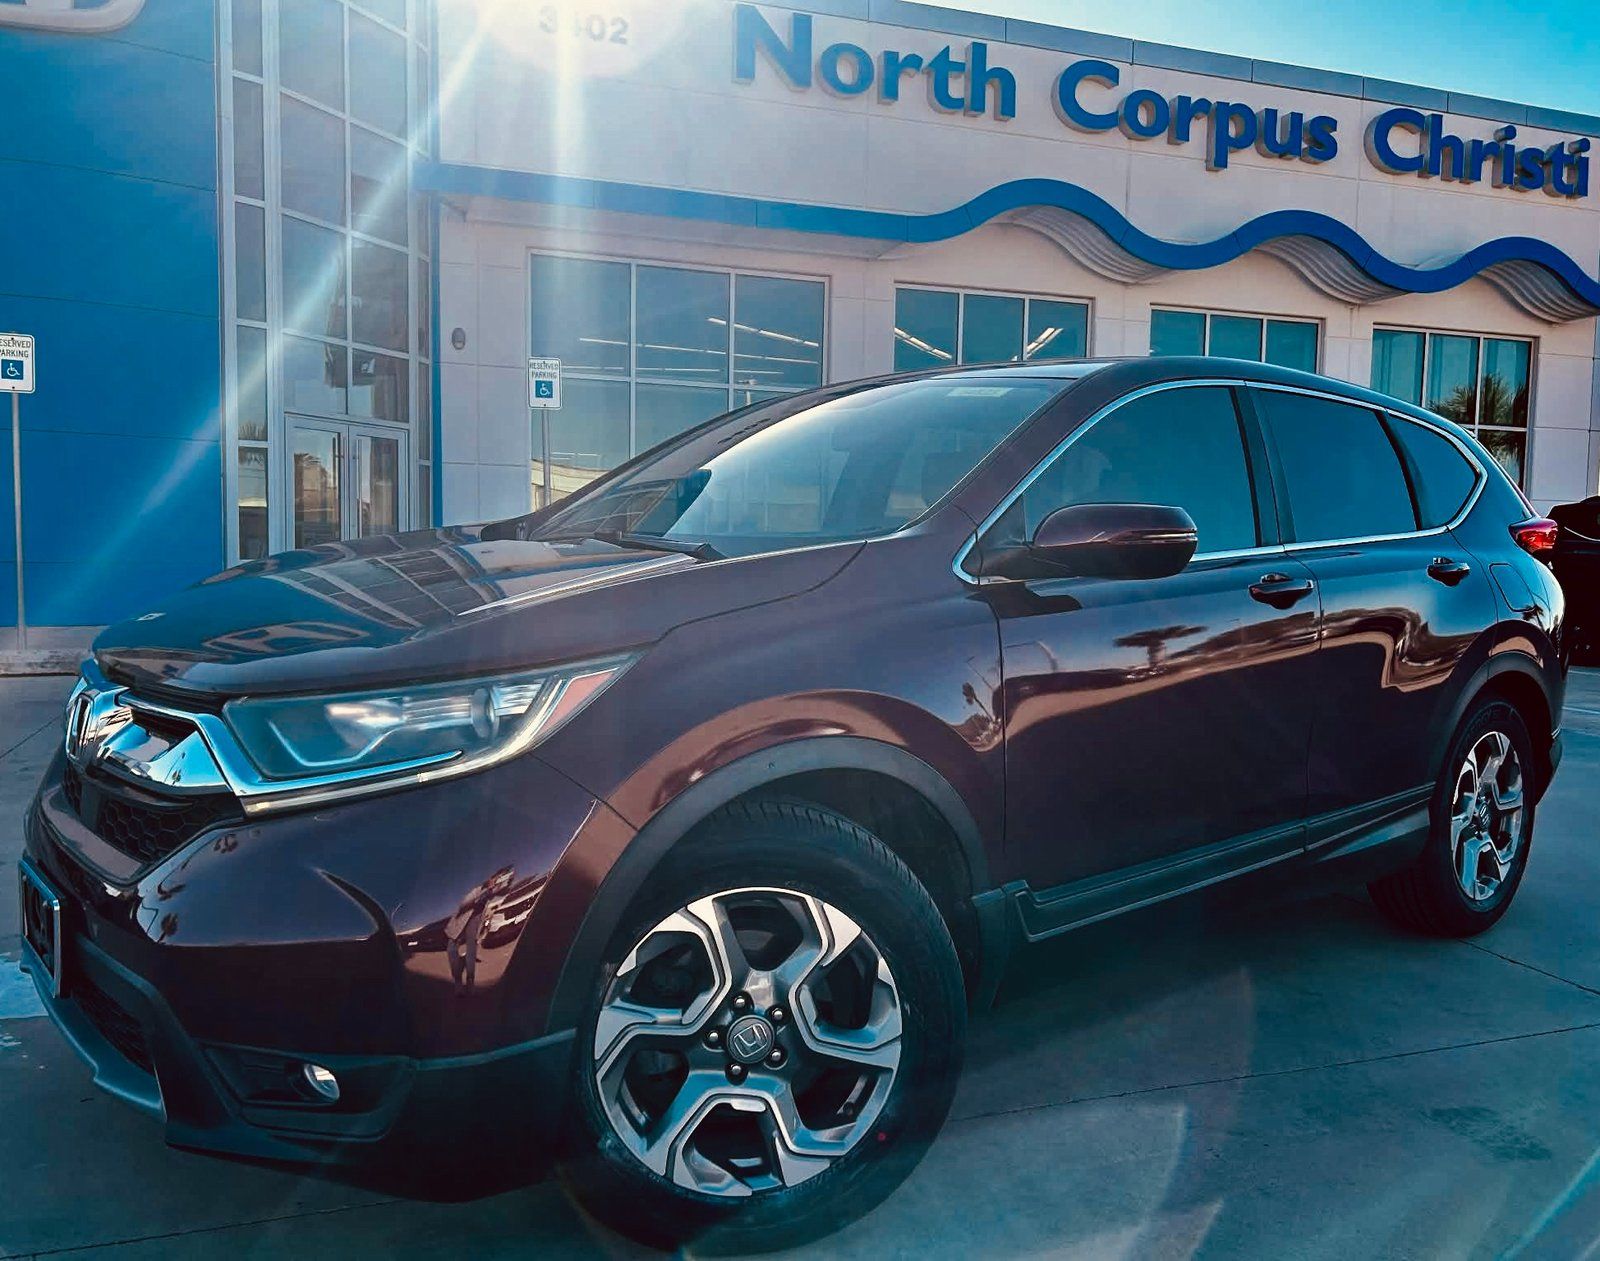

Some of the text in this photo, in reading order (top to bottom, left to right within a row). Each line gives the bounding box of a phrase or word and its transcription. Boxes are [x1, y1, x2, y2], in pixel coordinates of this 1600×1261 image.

[539, 5, 629, 45] 302
[732, 3, 1590, 199] North Corpus Christi
[0, 339, 31, 348] ESERVED
[529, 362, 559, 370] RESERVED
[531, 371, 558, 379] PARKING
